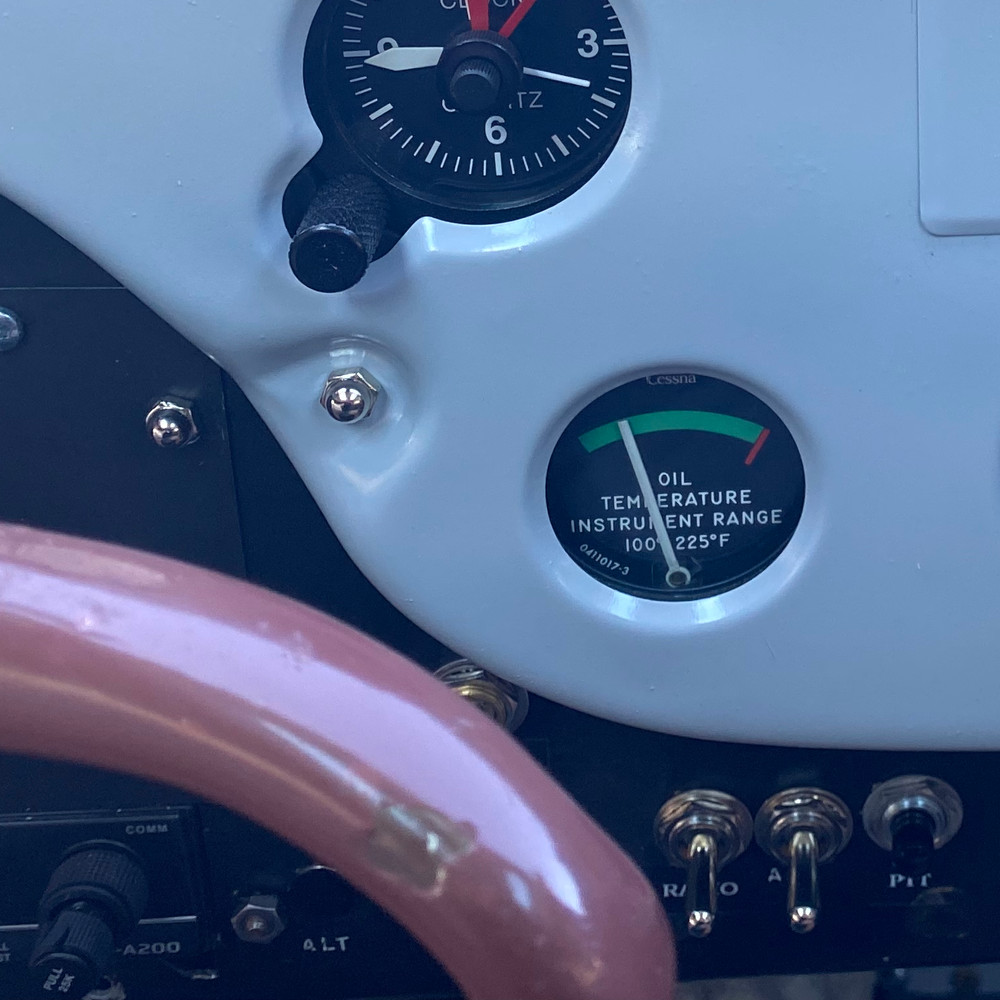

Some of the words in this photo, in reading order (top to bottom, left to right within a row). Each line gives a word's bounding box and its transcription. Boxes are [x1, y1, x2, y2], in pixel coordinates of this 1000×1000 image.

[576, 28, 600, 58] 3
[484, 115, 507, 145] 6
[646, 373, 697, 386] Cessna
[658, 471, 692, 486] OIL
[713, 509, 783, 527] RANGE
[579, 543, 631, 576] 0411017-3
[125, 824, 169, 836] COMM
[303, 936, 349, 952] ALT
